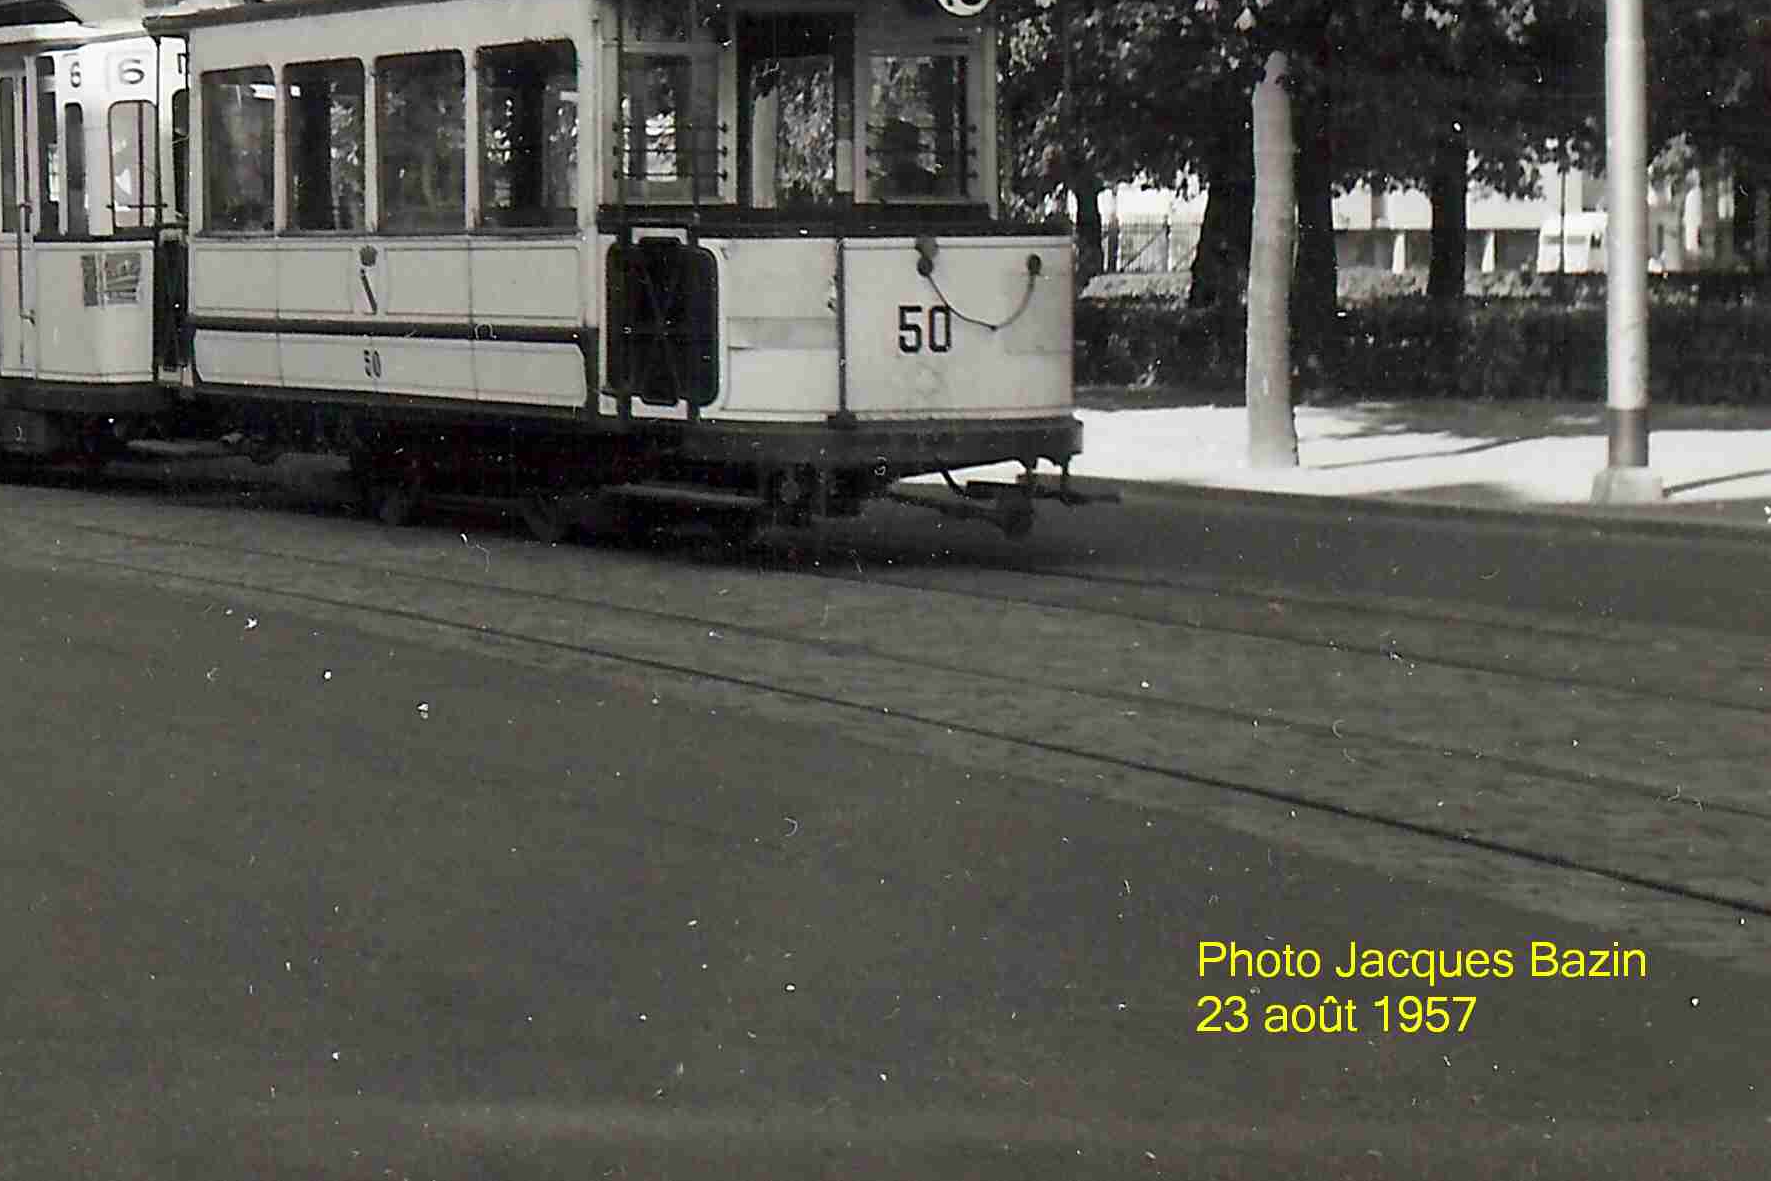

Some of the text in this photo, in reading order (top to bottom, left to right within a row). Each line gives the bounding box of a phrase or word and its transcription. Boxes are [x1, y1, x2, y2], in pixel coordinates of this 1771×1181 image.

[118, 58, 145, 85] 6
[899, 305, 952, 353] 50
[363, 349, 382, 379] 50
